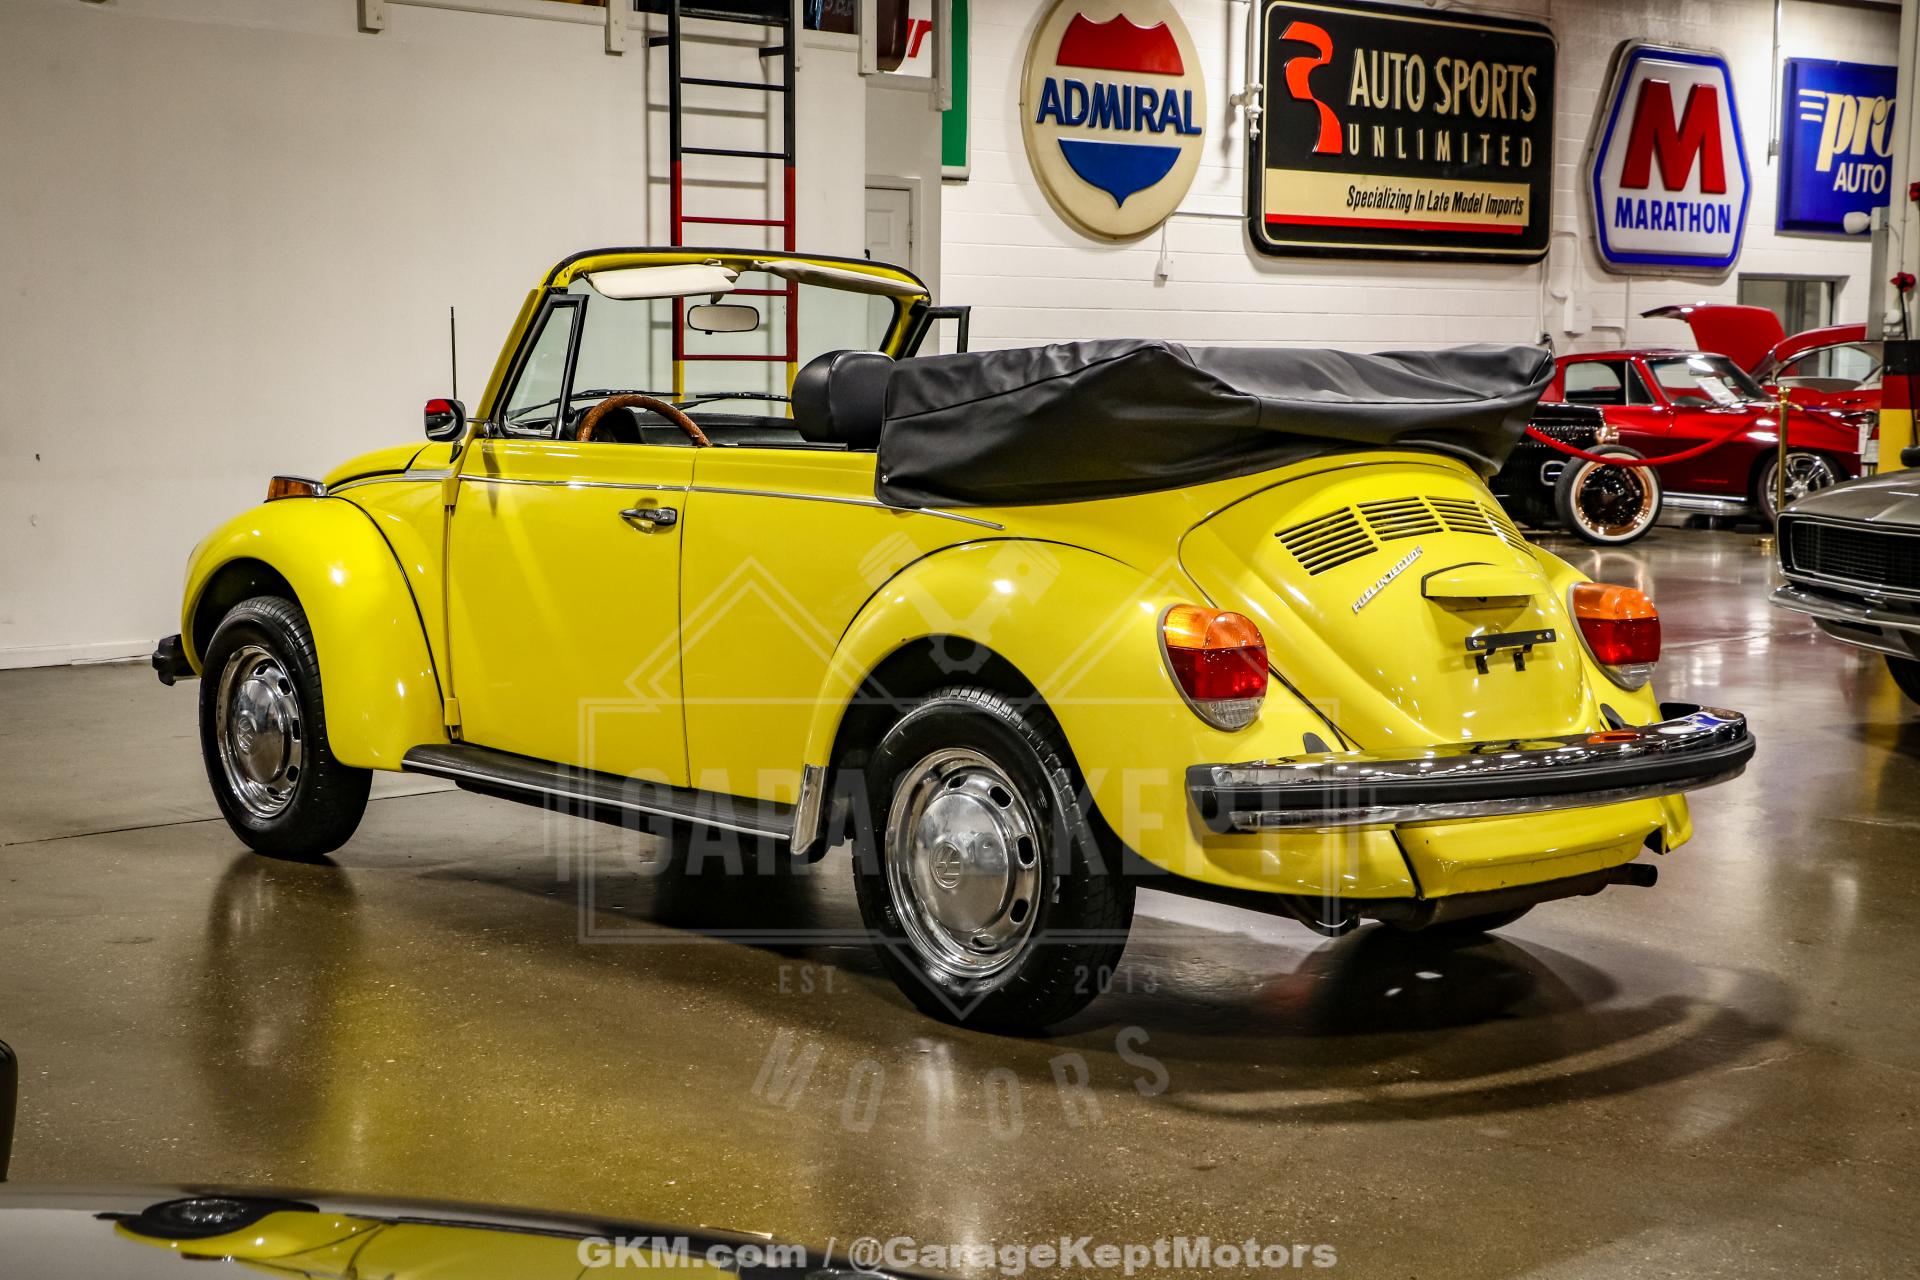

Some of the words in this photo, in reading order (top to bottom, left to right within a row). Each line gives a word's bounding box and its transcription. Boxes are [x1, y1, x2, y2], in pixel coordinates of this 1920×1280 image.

[1036, 76, 1202, 135] ADMIRAL
[1348, 48, 1426, 113] AUTO
[1434, 56, 1537, 122] SPORTS
[1348, 122, 1532, 168] UNLIMITED
[1833, 161, 1886, 194] AUTO
[1346, 184, 1412, 214] Specializing
[1413, 189, 1425, 211] In
[1426, 189, 1450, 213] Late
[1451, 191, 1484, 214] Model
[1484, 192, 1525, 218] Imports
[1614, 196, 1731, 234] MARATHON
